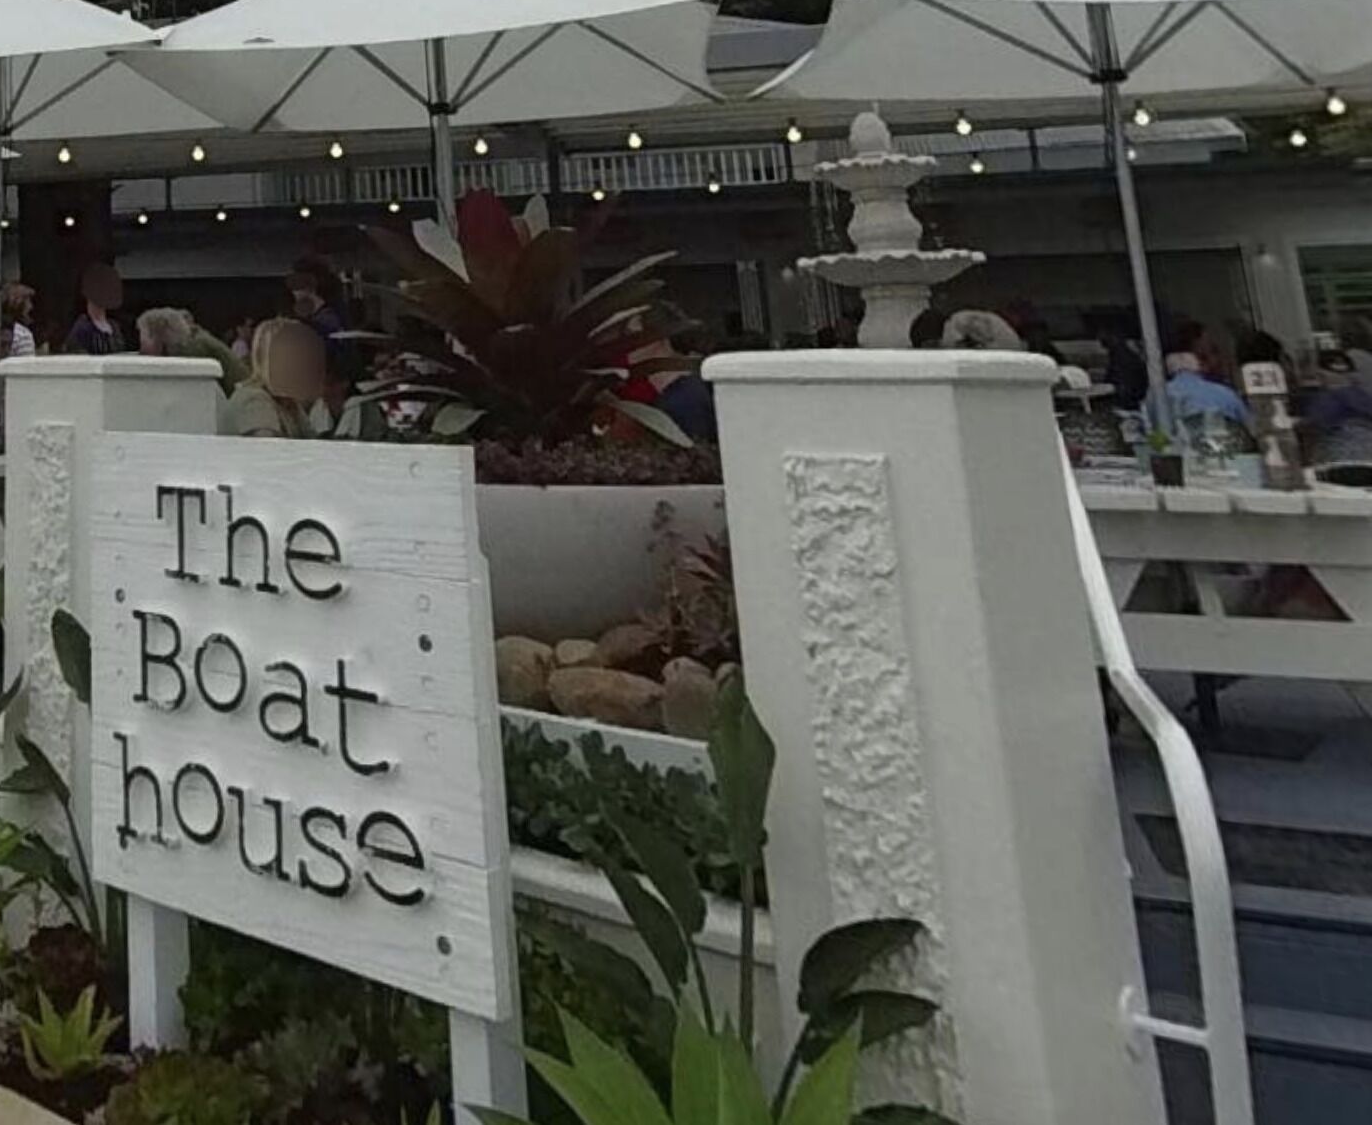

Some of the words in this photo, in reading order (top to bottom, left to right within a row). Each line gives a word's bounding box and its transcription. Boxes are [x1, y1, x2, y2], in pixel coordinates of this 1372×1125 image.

[156, 484, 344, 600] The
[132, 609, 390, 774] Boat
[114, 731, 426, 906] house
